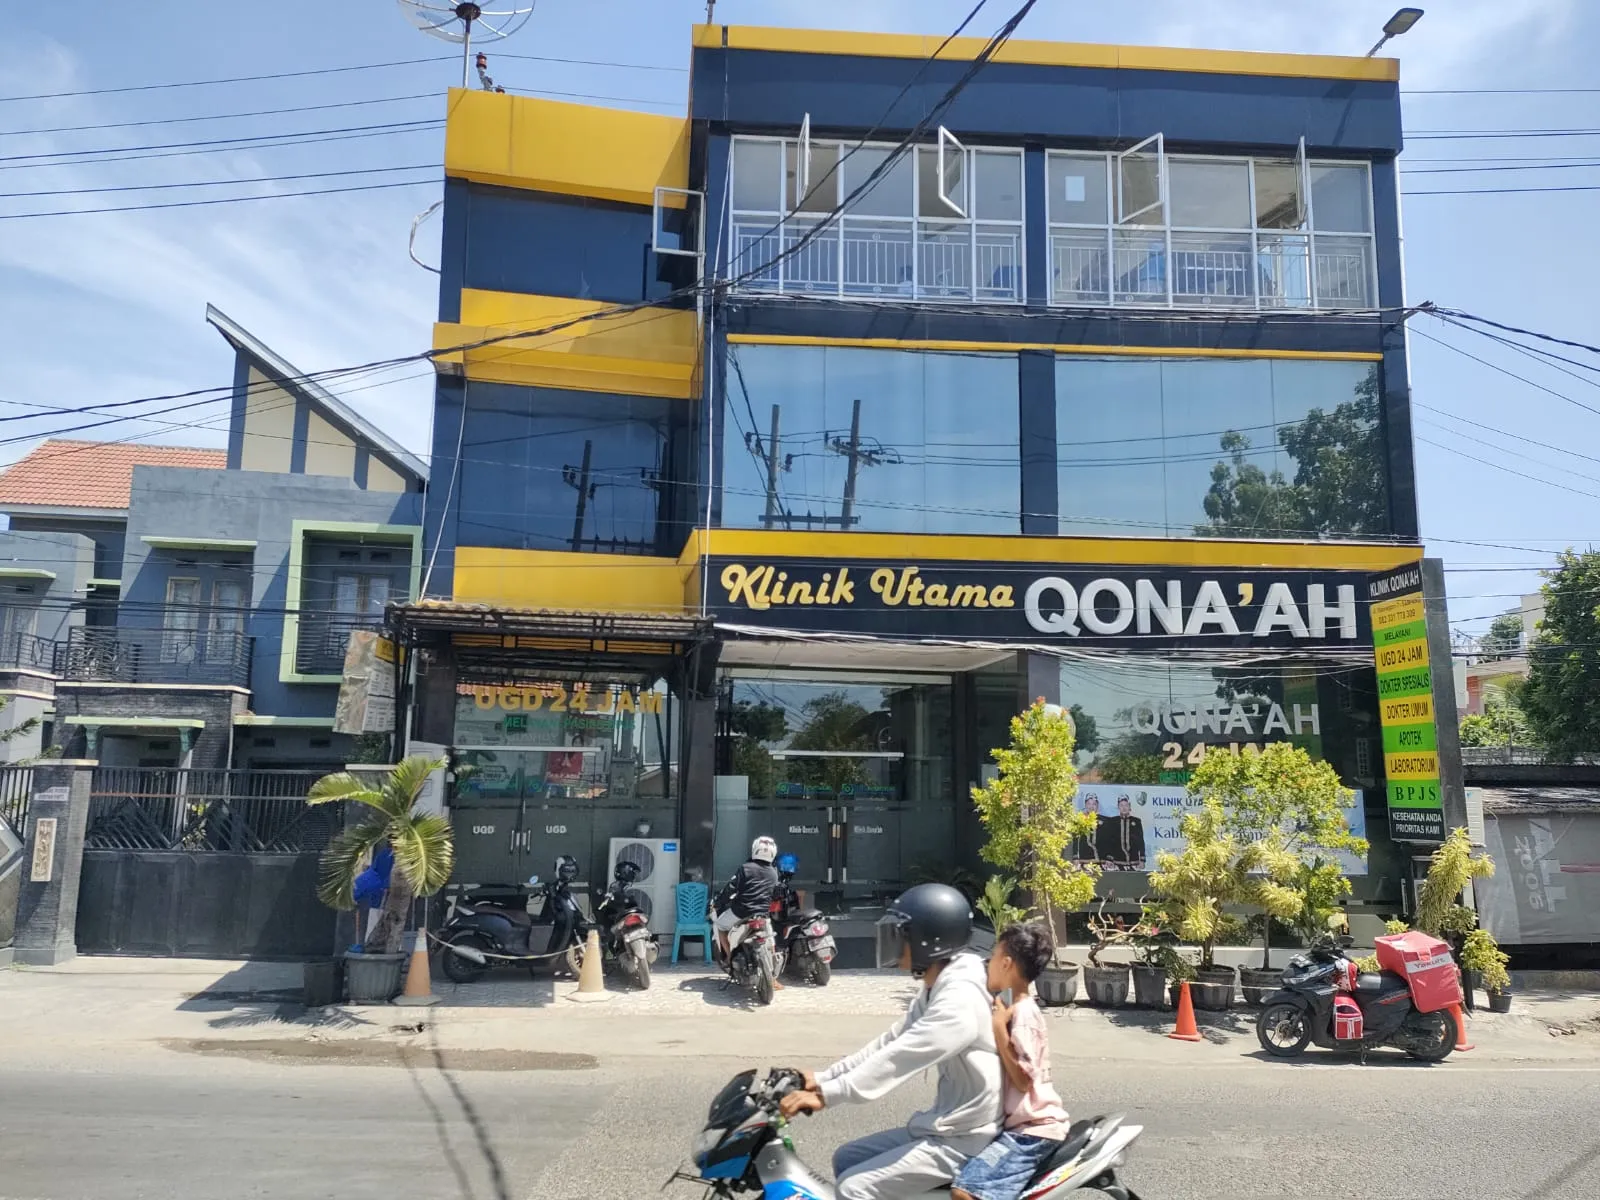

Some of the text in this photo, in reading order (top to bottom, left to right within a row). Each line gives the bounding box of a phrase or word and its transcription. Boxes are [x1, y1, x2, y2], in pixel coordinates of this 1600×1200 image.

[1369, 569, 1420, 597] KLINIK QONA'AH
[720, 564, 1357, 639] Klinik Utama QONA'AH
[1384, 628, 1411, 640] MELAYANI
[1380, 645, 1423, 667] UGD 24 JAM
[1380, 673, 1429, 694] DOKTER SPESIALIS
[474, 686, 663, 714] UGD 24 JAM
[1386, 701, 1428, 719] DOKTER UMUM
[1131, 702, 1320, 736] QONA'AH
[1399, 730, 1422, 746] APOTEK
[1162, 742, 1206, 768] 24
[1391, 758, 1436, 773] LABORATORIUM
[1152, 796, 1182, 807] KLINIK
[1392, 812, 1442, 822] KESEHATAN ANDA
[472, 825, 494, 834] UGD
[546, 825, 567, 834] UGD
[1395, 824, 1440, 834] PRIORITAS KAMI
